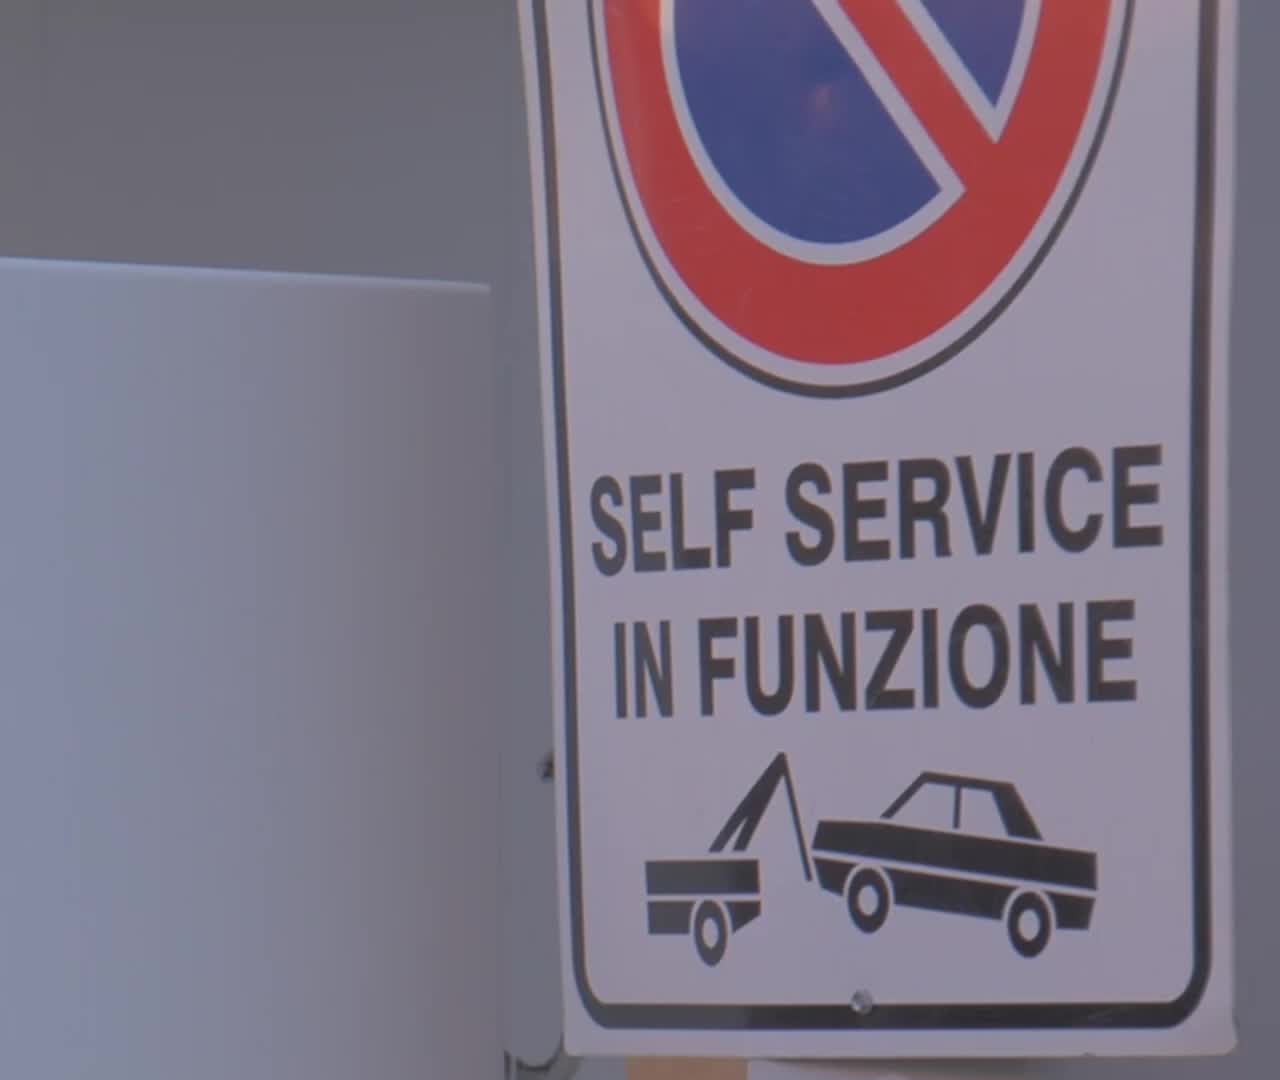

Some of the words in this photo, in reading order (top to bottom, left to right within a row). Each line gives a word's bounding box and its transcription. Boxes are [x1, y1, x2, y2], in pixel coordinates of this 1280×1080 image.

[590, 467, 756, 577] SELF
[784, 443, 1164, 567] SERVICE
[614, 619, 674, 719] IN
[698, 599, 1137, 717] FUNZIONE
